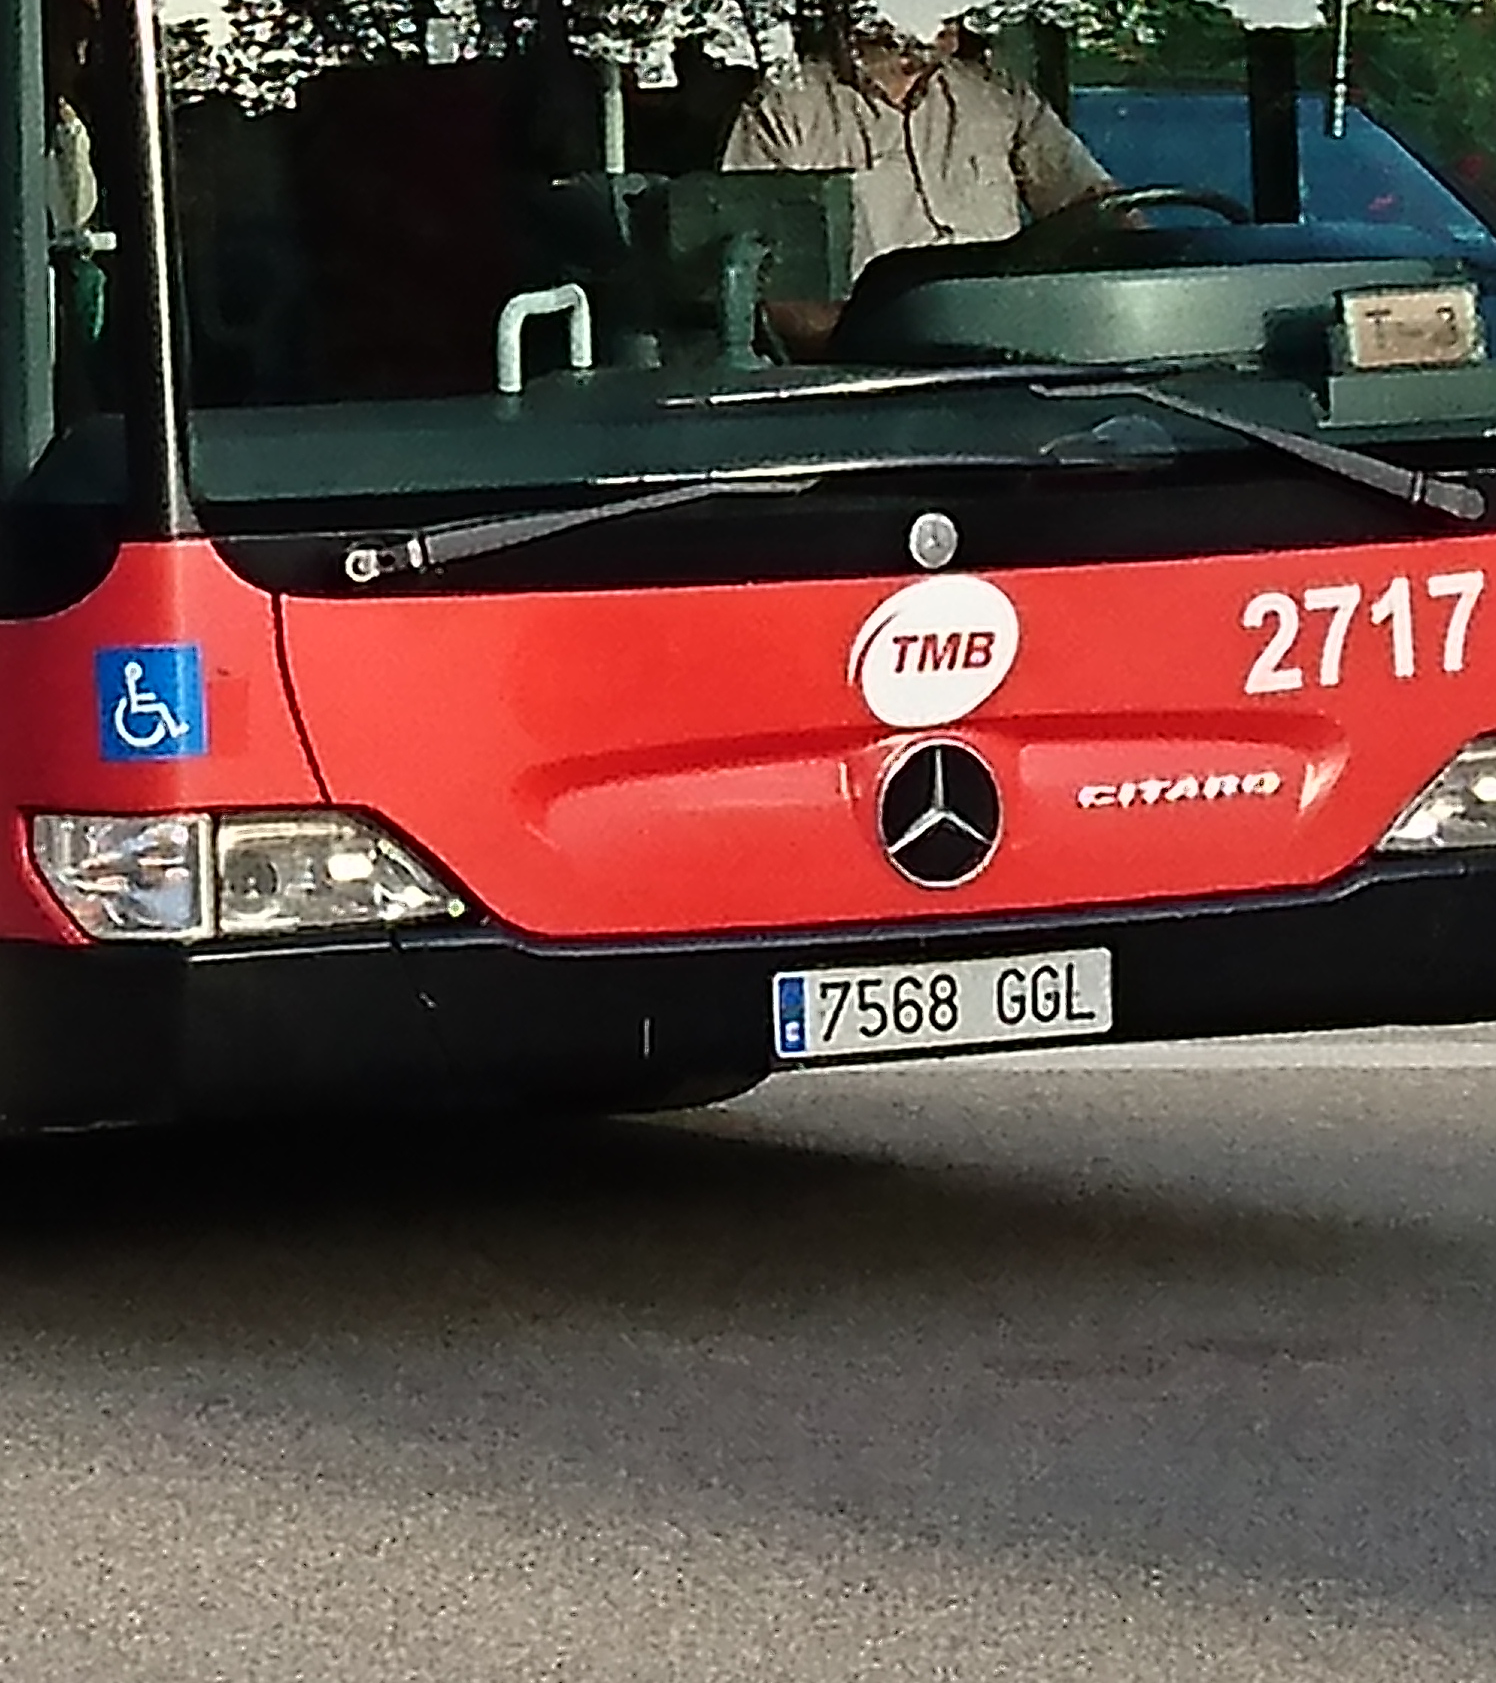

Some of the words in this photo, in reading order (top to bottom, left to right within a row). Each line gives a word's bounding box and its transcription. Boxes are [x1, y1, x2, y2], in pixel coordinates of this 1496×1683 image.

[892, 631, 996, 674] TMB
[1241, 569, 1485, 695] 2717
[1077, 770, 1282, 809] CITARO
[819, 973, 958, 1042] 7568
[996, 962, 1096, 1025] GGL
